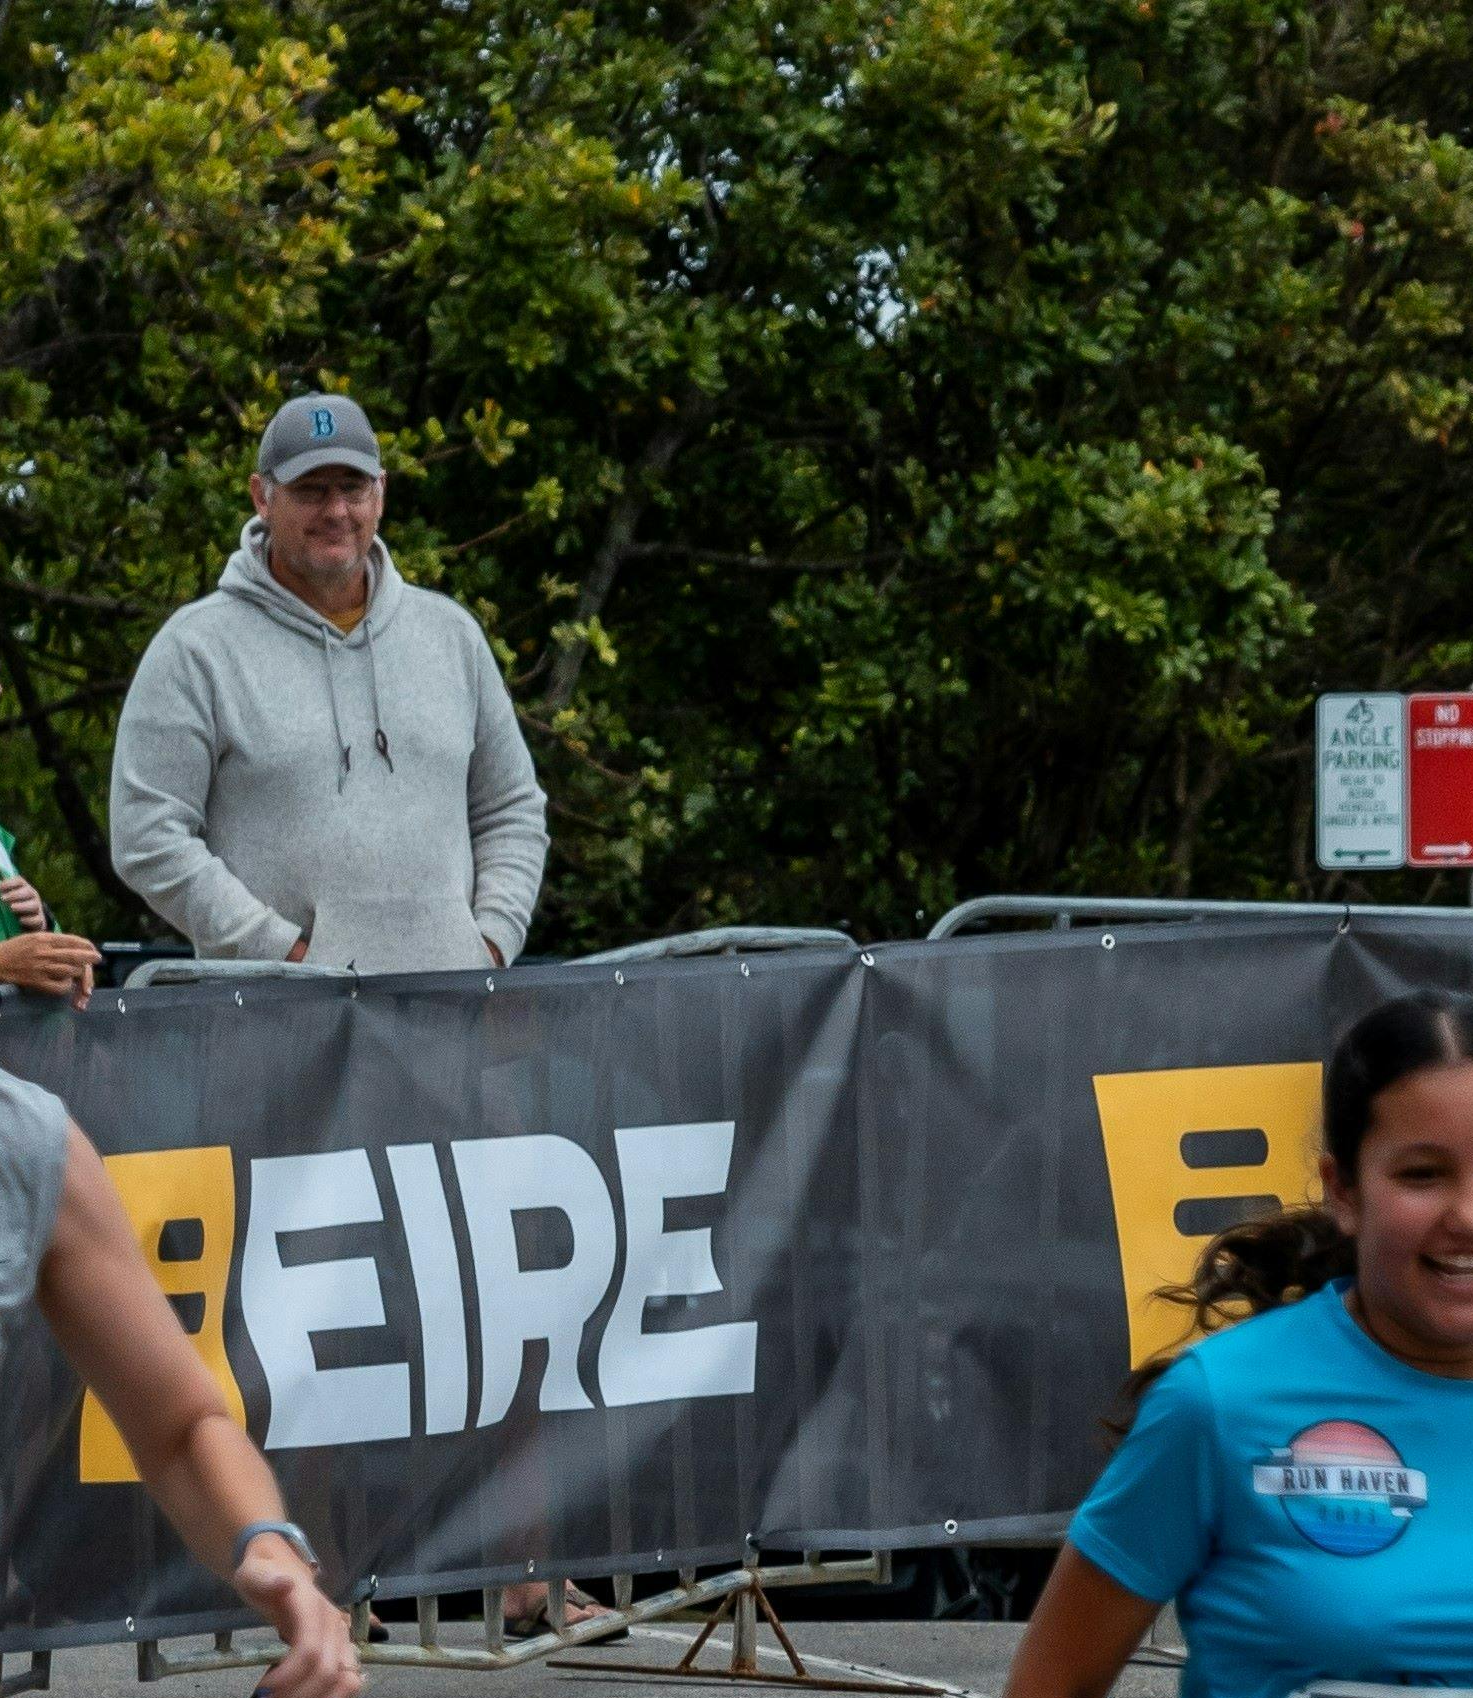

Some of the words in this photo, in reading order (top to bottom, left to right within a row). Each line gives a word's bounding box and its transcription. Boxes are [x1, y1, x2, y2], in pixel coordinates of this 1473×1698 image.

[310, 407, 335, 437] B
[1434, 704, 1460, 724] NO
[1330, 726, 1394, 746] ANGLE
[1324, 750, 1400, 769] PARKING
[1282, 1468, 1328, 1490] RUN
[1339, 1469, 1410, 1493] HAVEN
